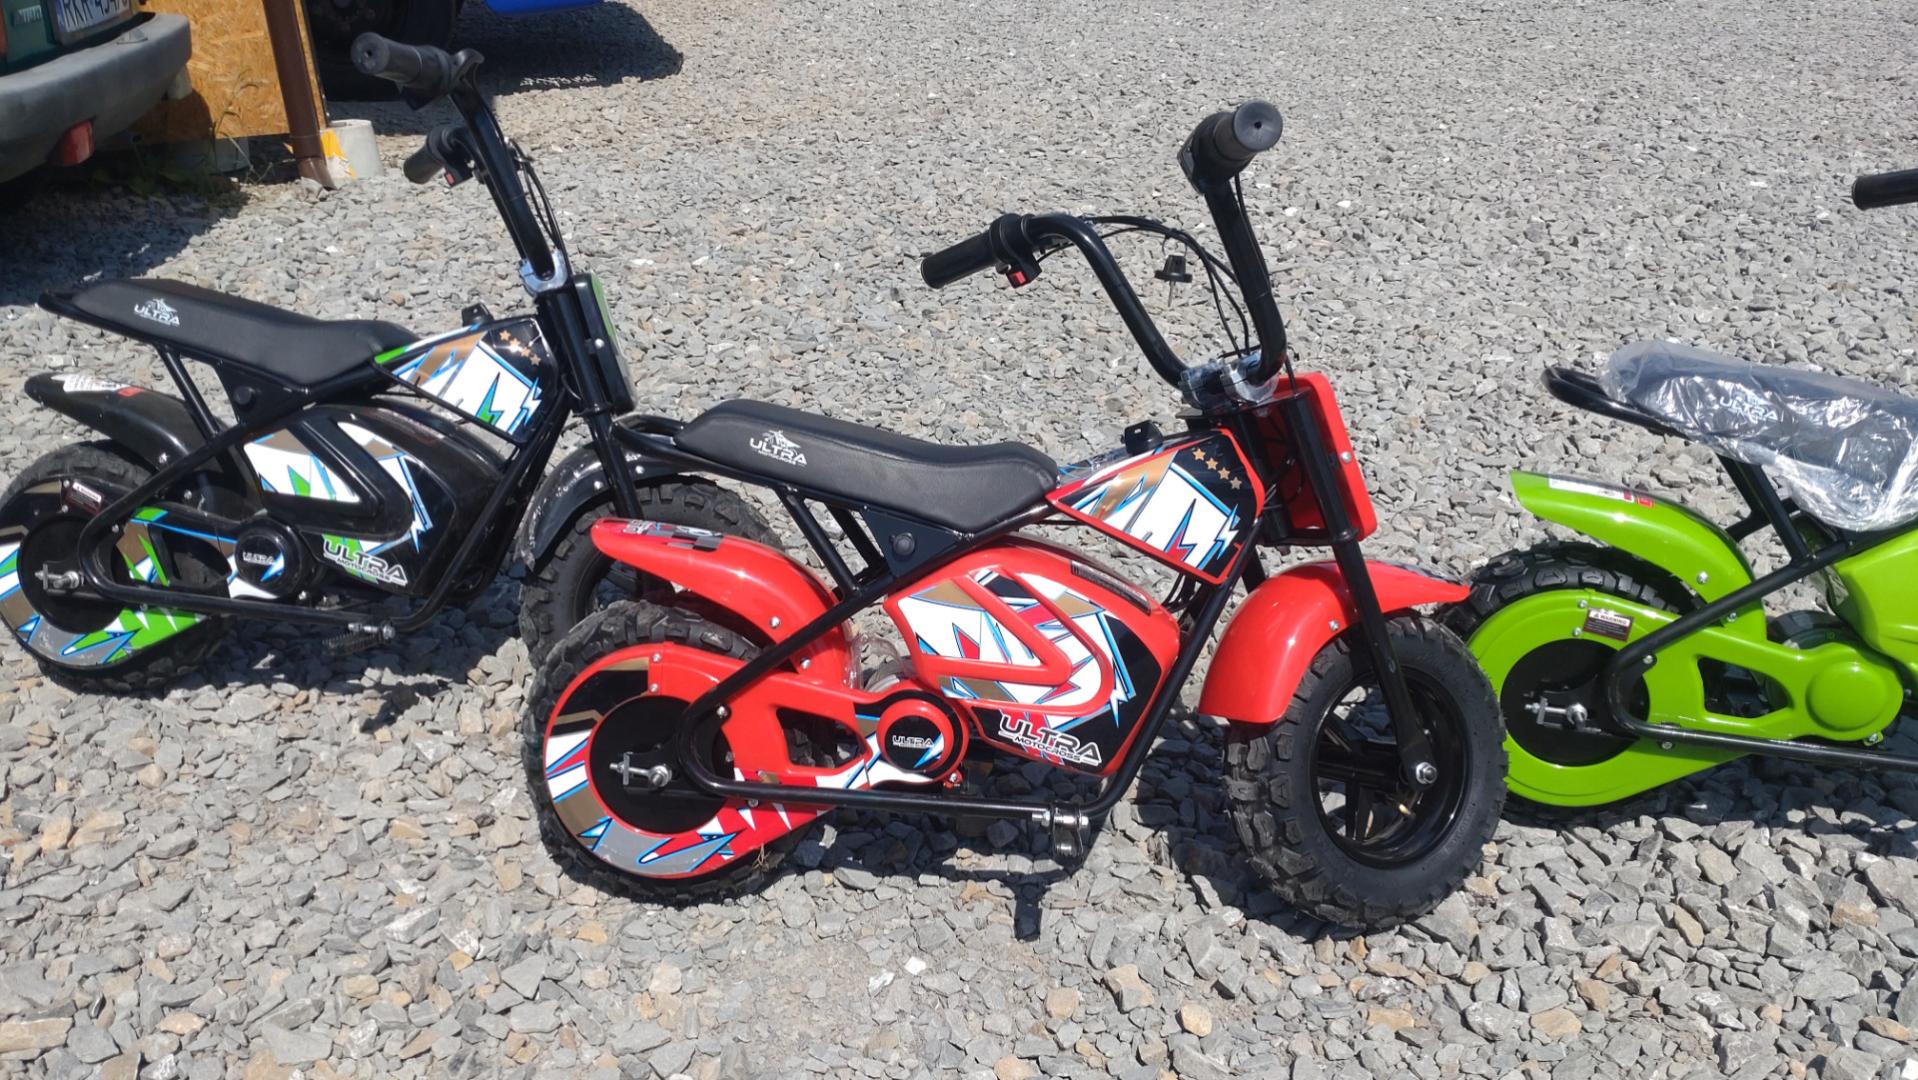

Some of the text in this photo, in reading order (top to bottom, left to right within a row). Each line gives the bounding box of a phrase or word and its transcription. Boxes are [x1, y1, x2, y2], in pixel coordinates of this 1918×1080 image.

[134, 303, 180, 326] ULTRA
[749, 437, 808, 465] ULTRA
[324, 539, 408, 583] ULTRA
[892, 735, 935, 748] ULTRA
[1000, 714, 1101, 763] ULTRA
[1013, 735, 1081, 763] MOTOCROSS
